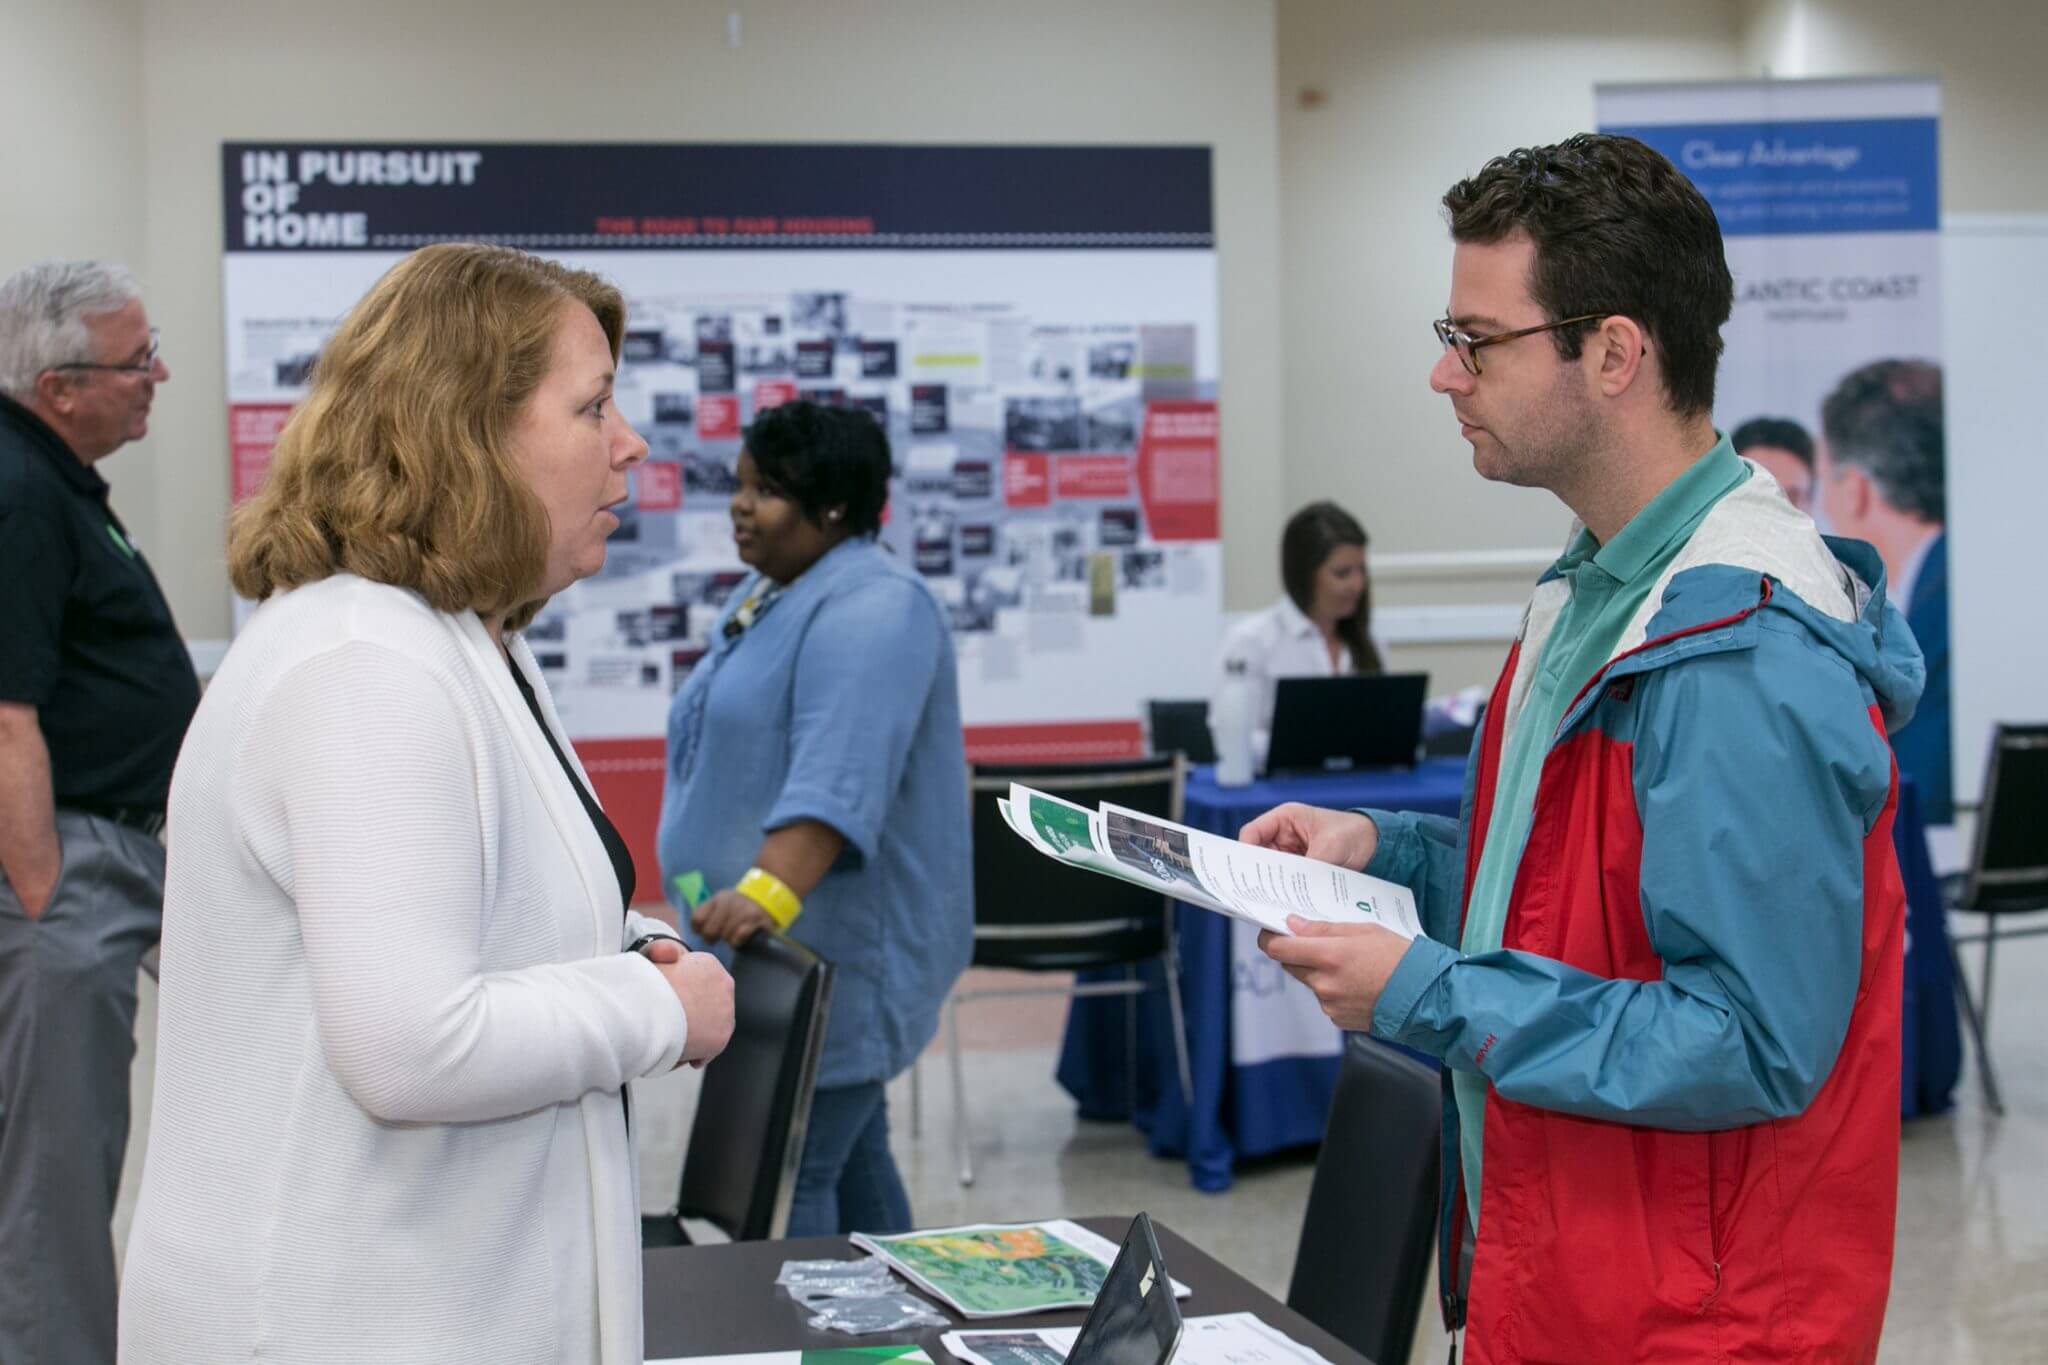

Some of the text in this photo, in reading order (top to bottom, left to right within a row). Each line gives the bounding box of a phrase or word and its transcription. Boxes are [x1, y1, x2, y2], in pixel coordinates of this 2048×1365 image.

[242, 152, 481, 185] IN PURSUIT
[242, 183, 299, 215] OF
[243, 212, 368, 246] HOME
[1829, 274, 1920, 302] COAST
